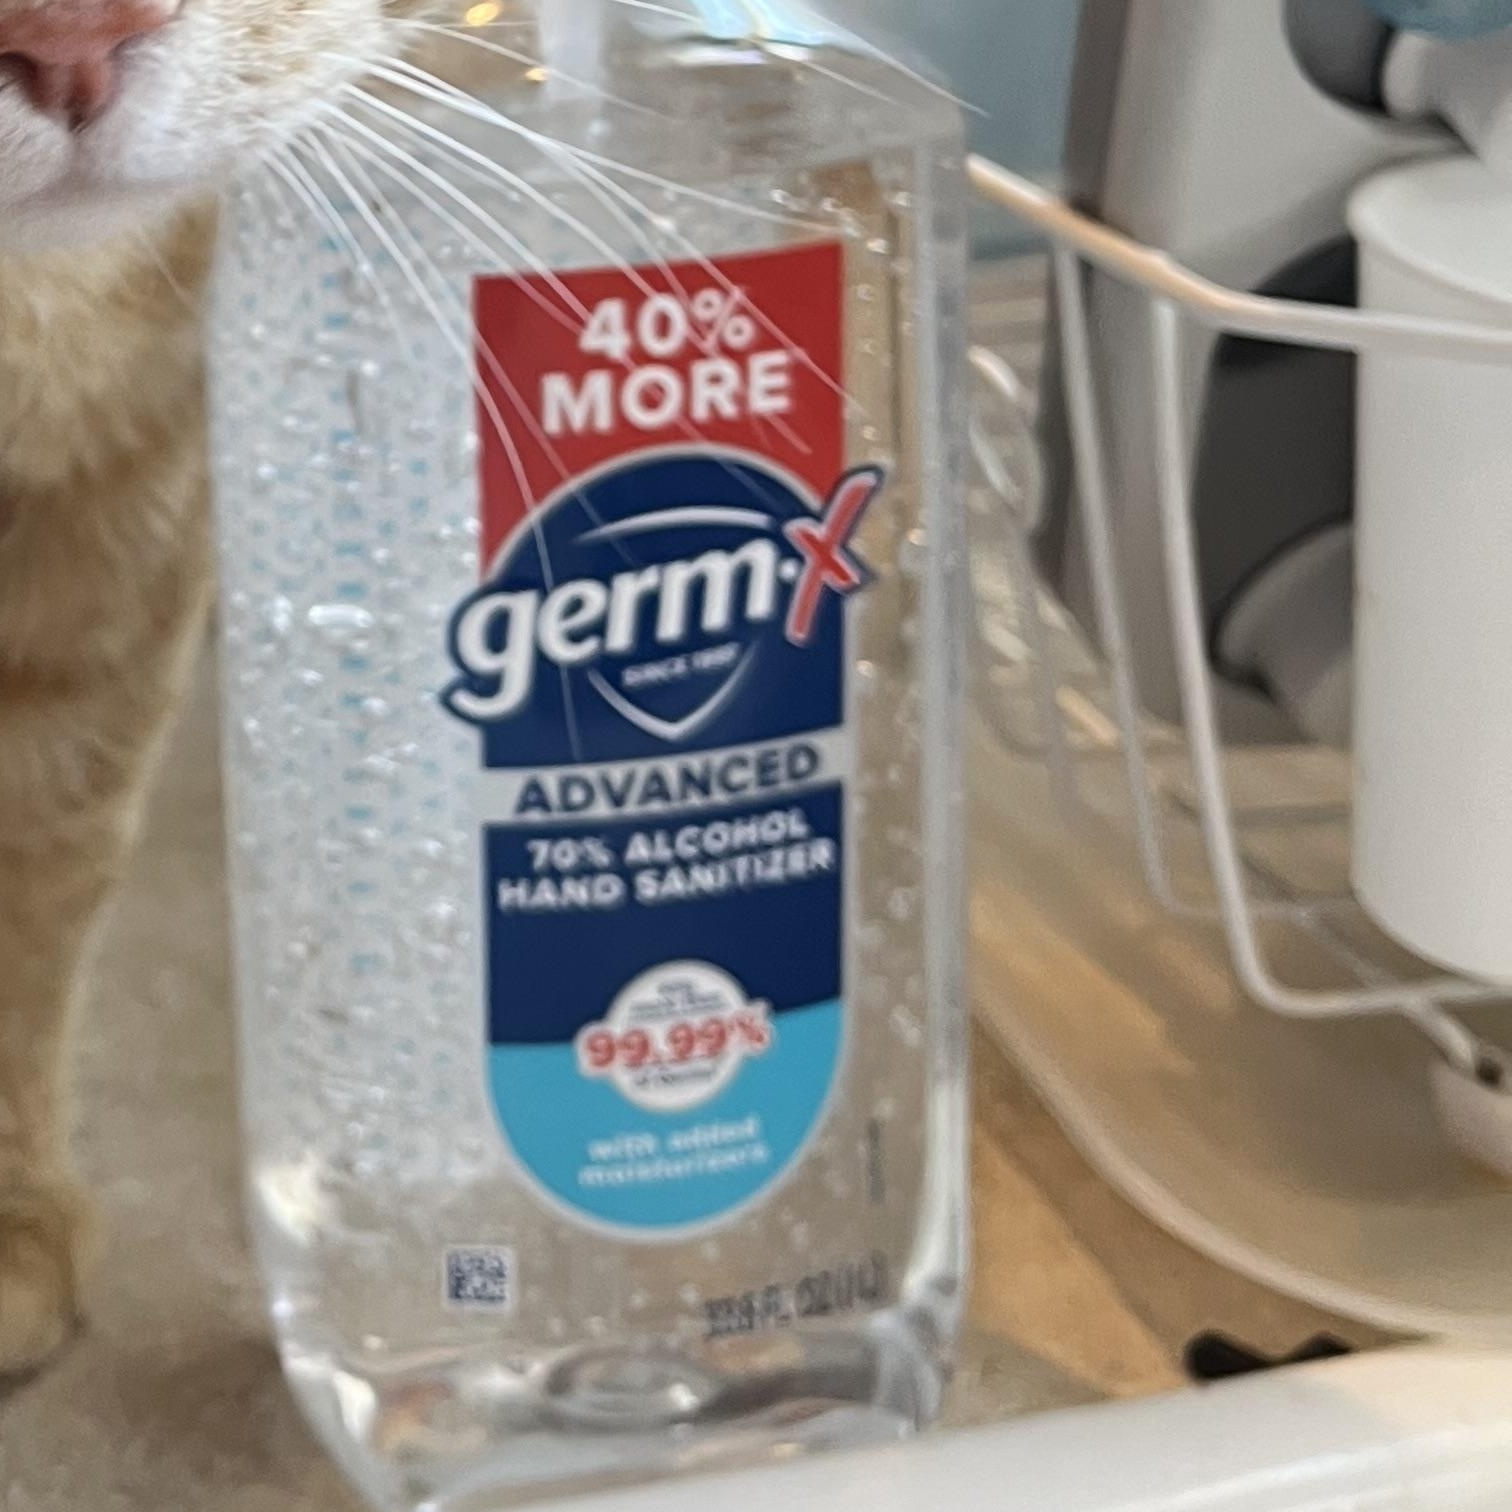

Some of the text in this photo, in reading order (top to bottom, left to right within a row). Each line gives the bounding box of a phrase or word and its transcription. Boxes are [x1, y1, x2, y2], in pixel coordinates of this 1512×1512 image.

[579, 288, 756, 358] 40%
[541, 350, 792, 435] MORE
[513, 743, 820, 814] ADVANCED
[527, 807, 810, 872] 70% ALCOHOL
[497, 838, 836, 913] HAND SANITIZER
[584, 1010, 766, 1071] 99.99%
